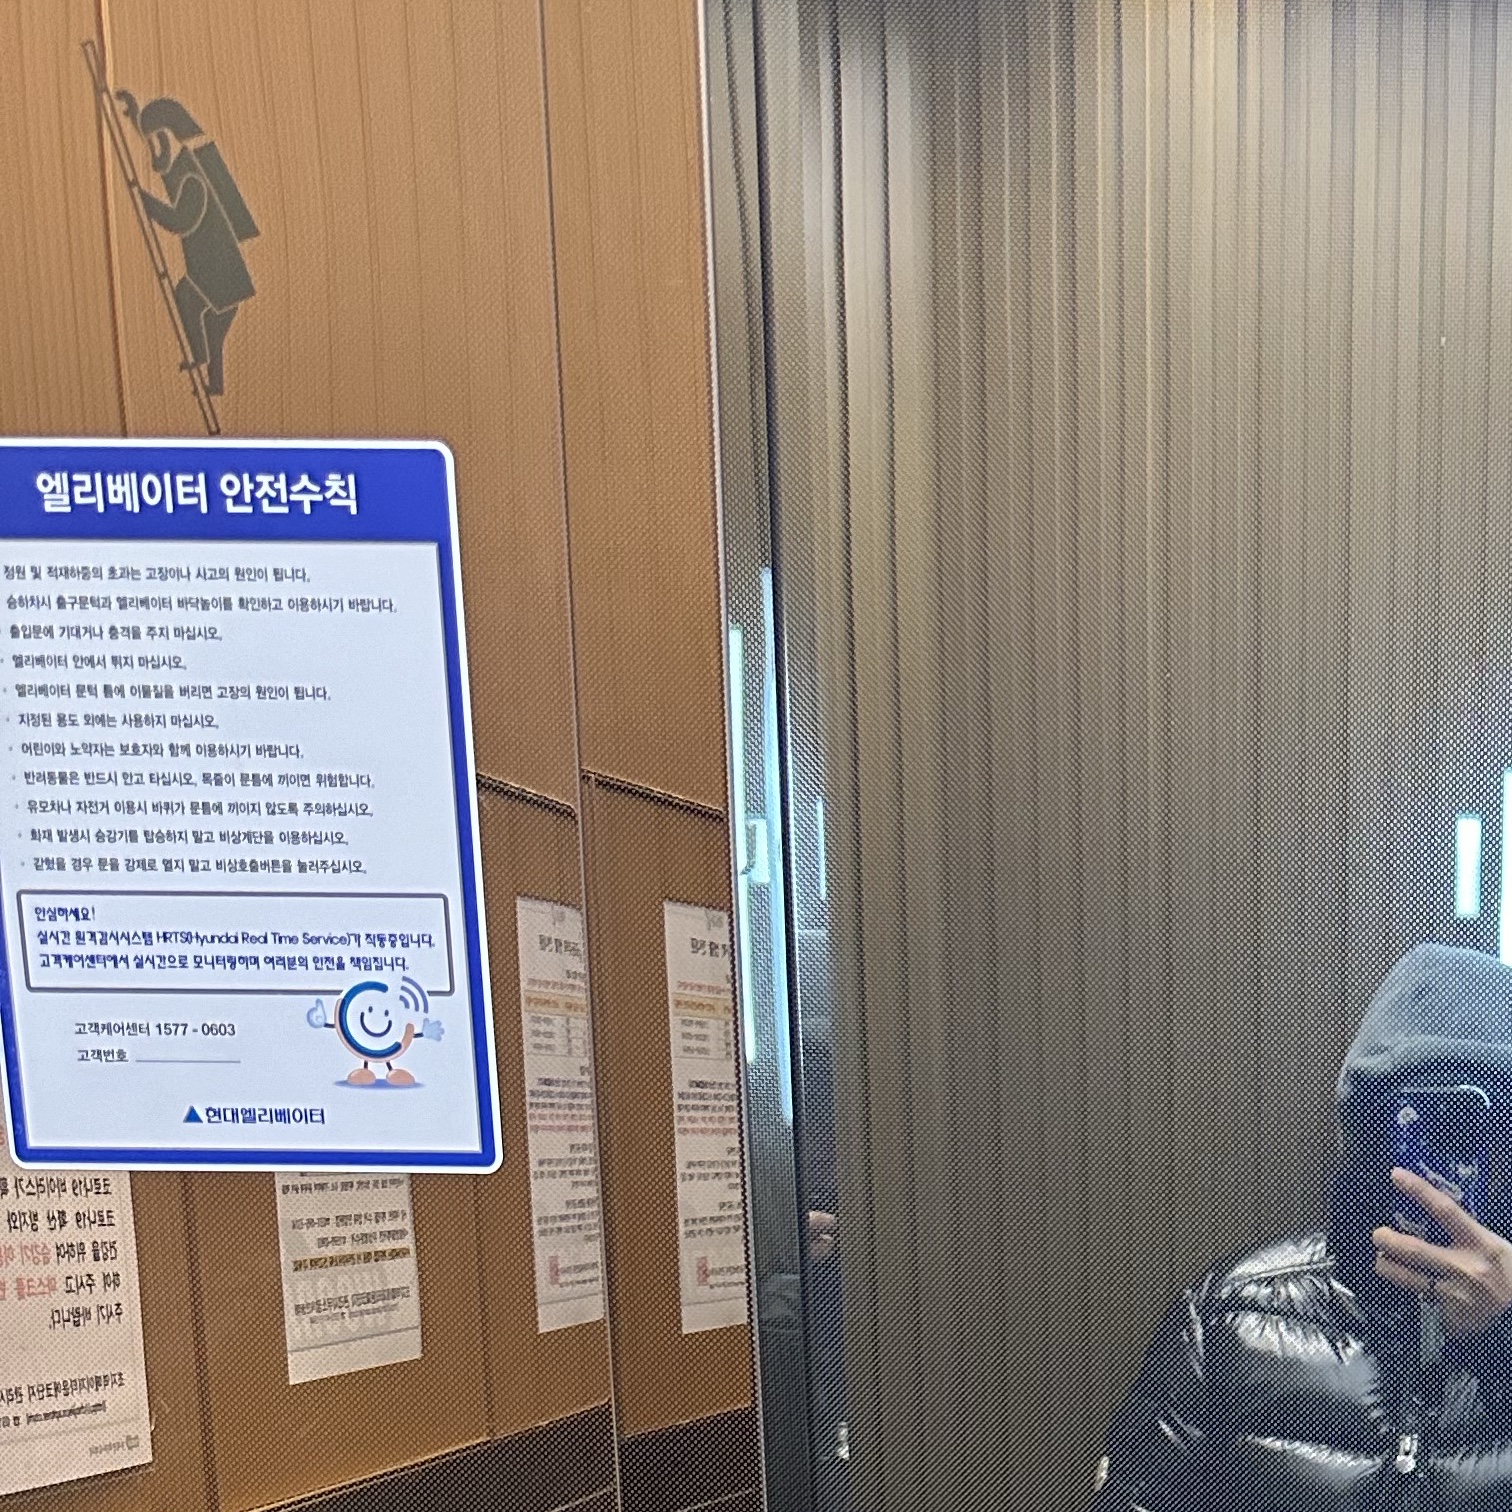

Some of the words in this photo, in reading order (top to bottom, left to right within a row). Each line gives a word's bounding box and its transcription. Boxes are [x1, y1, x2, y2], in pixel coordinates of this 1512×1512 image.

[37, 472, 208, 513] 엘리베이터
[219, 474, 358, 515] 안전수칙
[4, 565, 26, 580] 정원
[31, 566, 42, 580] 및
[47, 566, 103, 580] 적재하중의
[108, 566, 141, 580] 초과는
[146, 567, 190, 581] 고장이나
[196, 567, 229, 581] 사고의
[235, 567, 268, 581] 원인이
[273, 568, 310, 583] 됩니다.
[7, 595, 51, 609] 승하차시
[117, 596, 172, 611] 엘리베이터
[178, 596, 232, 611] 바닥높이를
[238, 597, 283, 612] 확인하고
[288, 598, 343, 612] 이용하시기
[349, 598, 397, 613] 바랍니다.
[10, 624, 54, 639] 출입문에
[59, 625, 103, 639] 기대거나
[109, 625, 141, 640] 충격을
[146, 626, 169, 640] 주지
[174, 626, 222, 641] 마십시오.
[13, 655, 68, 669] 엘리베이터
[73, 655, 106, 669] 안에서
[111, 655, 134, 669] 뛰지
[138, 655, 187, 670] 마십시오.
[16, 684, 70, 698] 엘리베이터
[76, 684, 98, 698] 문턱
[103, 684, 125, 698] 틈에
[130, 684, 174, 699] 이물질을
[179, 685, 212, 699] 버리면
[217, 685, 251, 700] 고장의
[256, 686, 289, 700] 원인이
[294, 686, 331, 701] 됩니다.
[19, 713, 51, 727] 지정된
[57, 714, 80, 727] 용도
[84, 714, 117, 728] 외에는
[122, 714, 166, 728] 사용하지
[171, 715, 219, 729] 마십시오.
[22, 742, 66, 756] 어린이와
[71, 742, 115, 757] 노약자는
[120, 743, 164, 757] 보호자와
[169, 743, 191, 757] 함께
[196, 743, 251, 758] 이용하시기
[256, 744, 304, 759] 바랍니다.
[24, 771, 79, 786] 반려동물은
[84, 772, 117, 786] 반드시
[122, 772, 145, 786] 안고
[202, 773, 235, 787] 목줄이
[240, 773, 273, 787] 문틈에
[278, 773, 311, 787] 끼이면
[316, 774, 375, 788] 위험합니다.
[27, 800, 71, 814] 유모차나
[76, 800, 109, 815] 자전거
[115, 801, 147, 815] 이용시
[152, 801, 185, 815] 바퀴가
[190, 801, 223, 816] 문틈에
[228, 802, 261, 816] 끼이지
[266, 802, 298, 816] 않도록
[303, 803, 373, 817] 주의하십시오.
[31, 829, 52, 843] 화재
[58, 829, 90, 843] 발생시
[95, 829, 138, 843] 승강기를
[144, 830, 188, 844] 탑승하지
[192, 830, 215, 844] 말고
[220, 831, 274, 845] 비상계단을
[280, 831, 348, 846] 이용하십시오.
[71, 858, 93, 871] 경우
[98, 858, 119, 872] 문을
[125, 858, 158, 872] 강제로
[162, 858, 185, 872] 열지
[189, 859, 211, 873] 말고
[216, 859, 292, 874] 비상호출버튼을
[297, 860, 367, 875] 눌러주십시오.
[35, 906, 96, 922] 안심하세요!
[38, 930, 70, 945] 실시간
[76, 931, 153, 946] 원격감시시스템
[242, 932, 268, 944] Real
[271, 933, 299, 945] Time
[365, 933, 435, 948] 작동중입니다.
[40, 954, 129, 969] 고객케어센터에서
[133, 954, 188, 969] 실시간으로
[194, 955, 260, 970] 모니터링하며
[264, 956, 309, 970] 여러분의
[313, 956, 345, 970] 안전을
[350, 957, 409, 971] 책임집니다.
[75, 1022, 150, 1036] 고객케어센터
[156, 1023, 188, 1036] 1577
[202, 1023, 236, 1036] 0603
[78, 1049, 128, 1062] 고객번호
[205, 1106, 326, 1125] 현대엘리베이터
